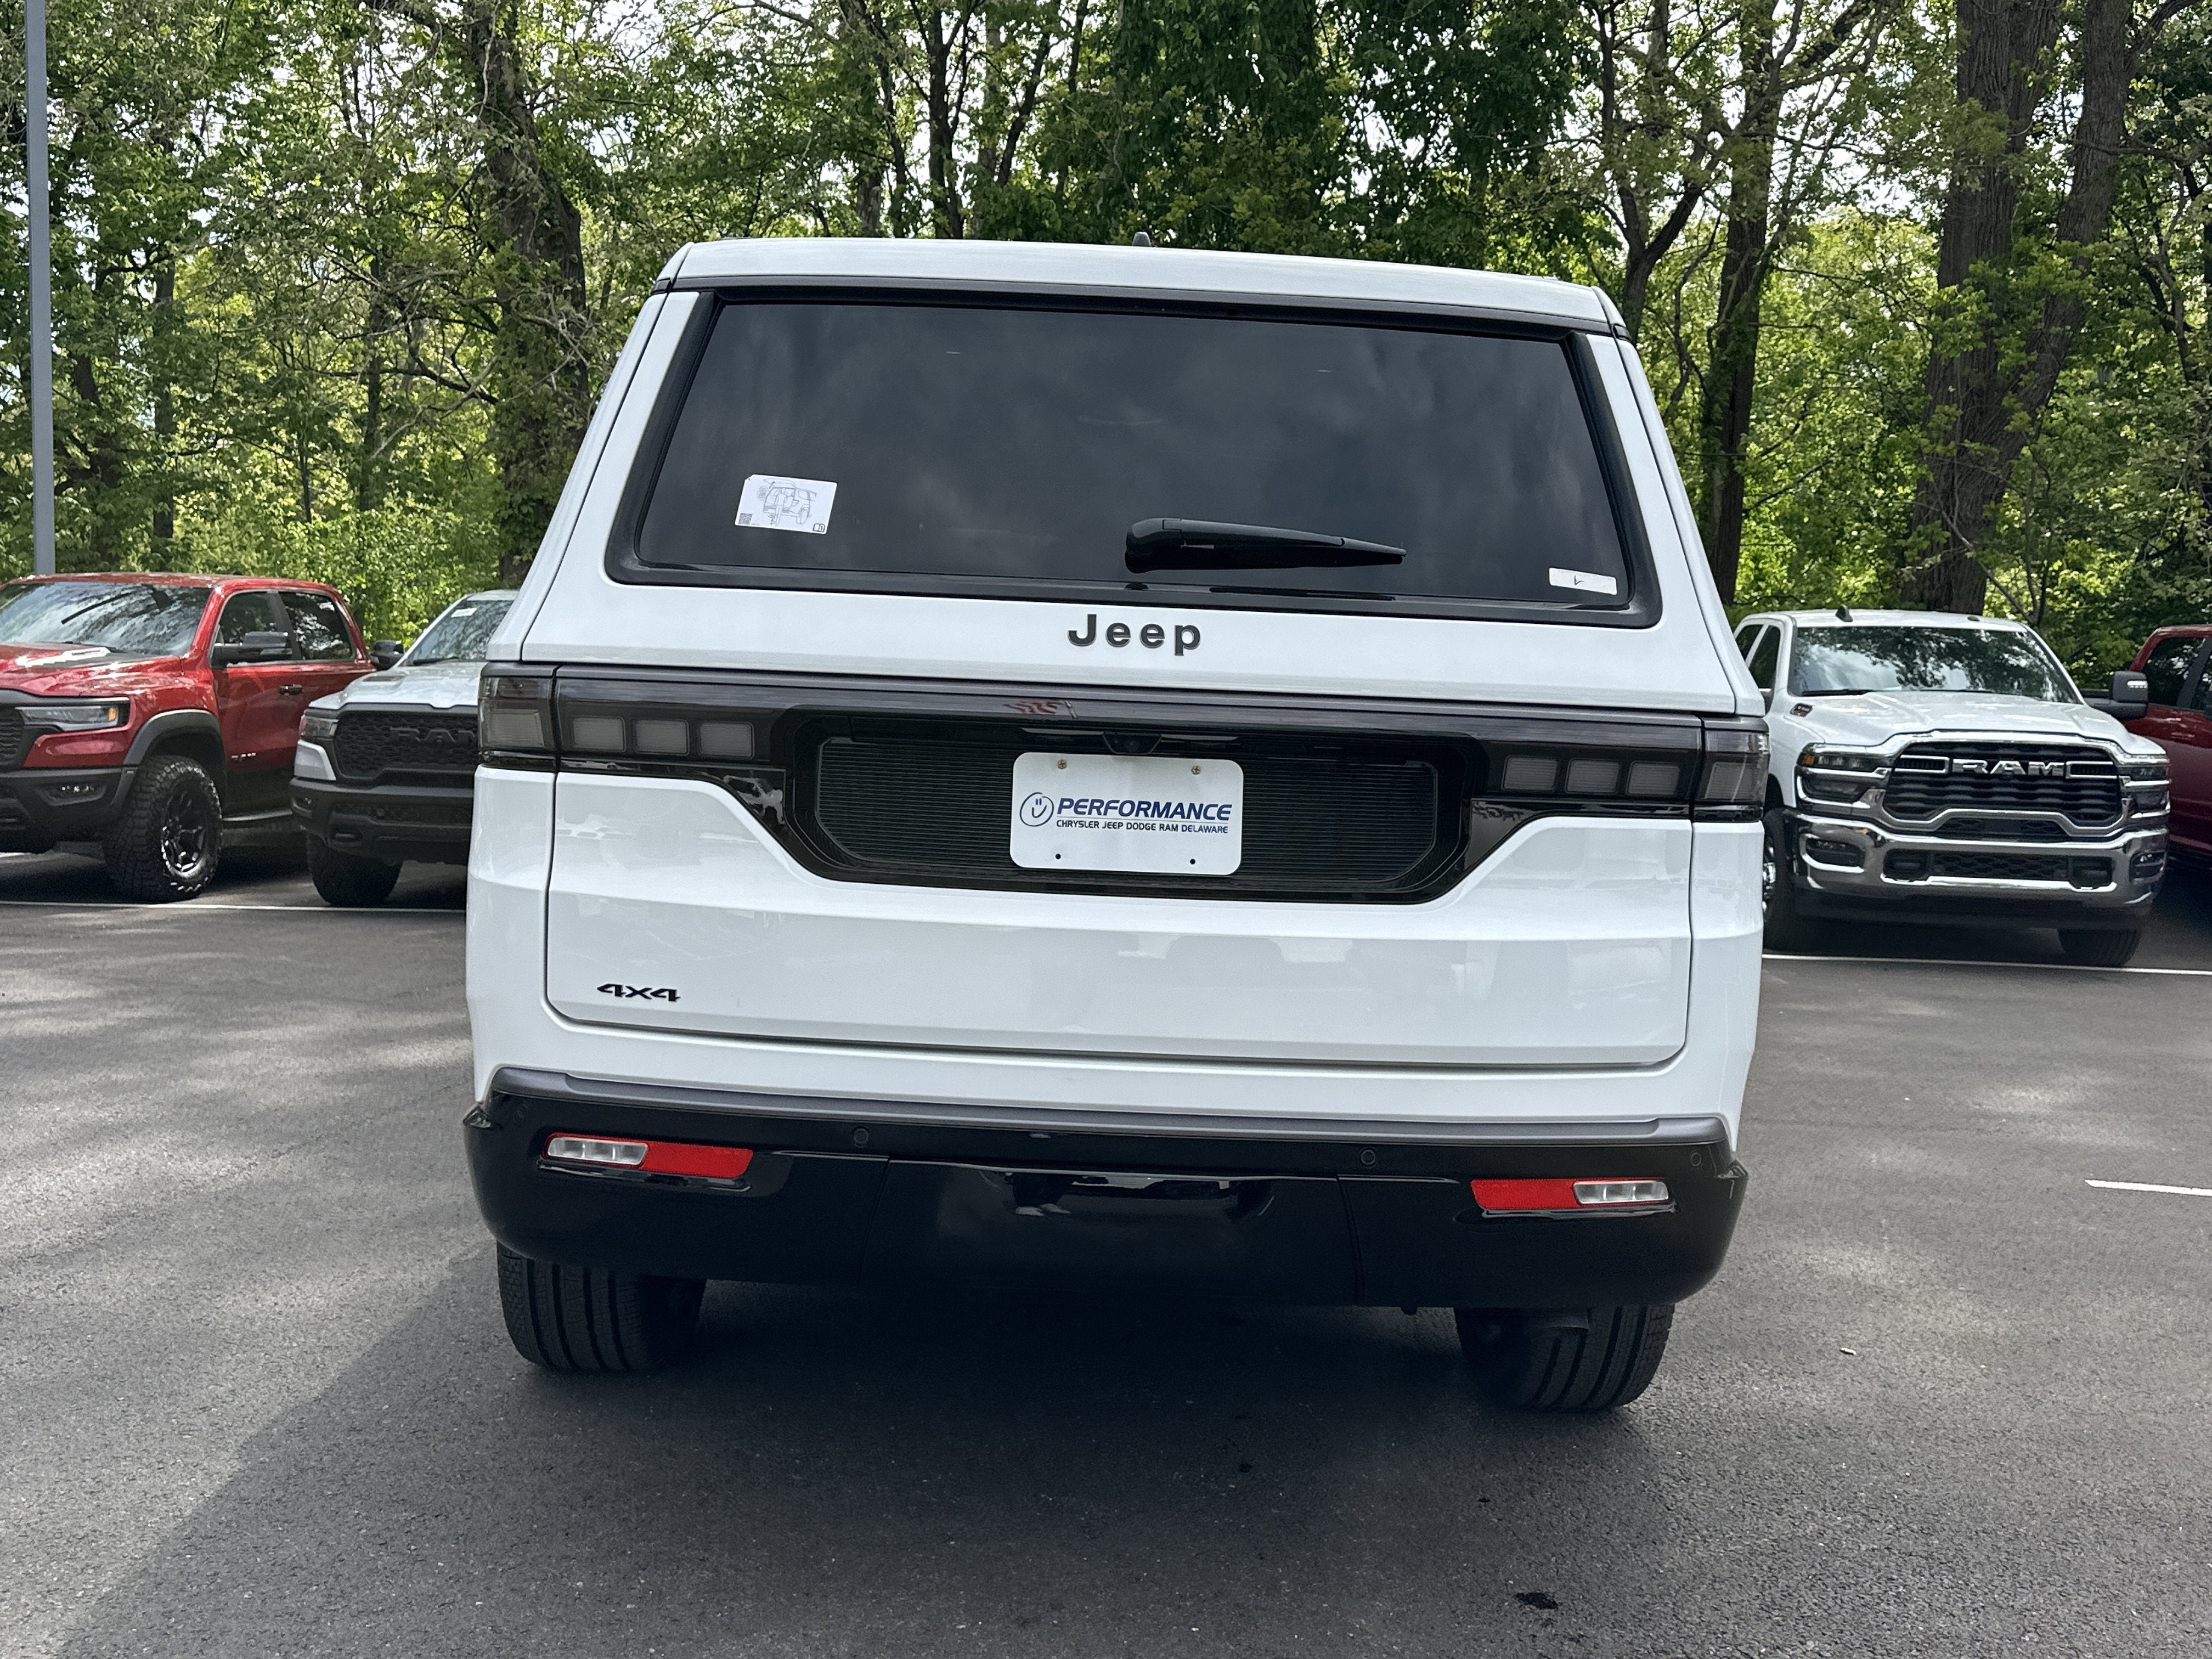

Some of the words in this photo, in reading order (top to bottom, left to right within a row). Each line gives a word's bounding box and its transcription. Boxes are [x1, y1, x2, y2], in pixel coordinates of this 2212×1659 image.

[1068, 614, 1200, 656] Jeep
[1952, 759, 2065, 776] RAM
[1057, 798, 1233, 820] PERFORMANCE
[1056, 819, 1099, 829] CHRYSLER
[1102, 821, 1124, 830] JEEP
[1126, 822, 1156, 831] DODGE
[1159, 823, 1178, 832] RAM
[1181, 825, 1228, 834] DELAWARE
